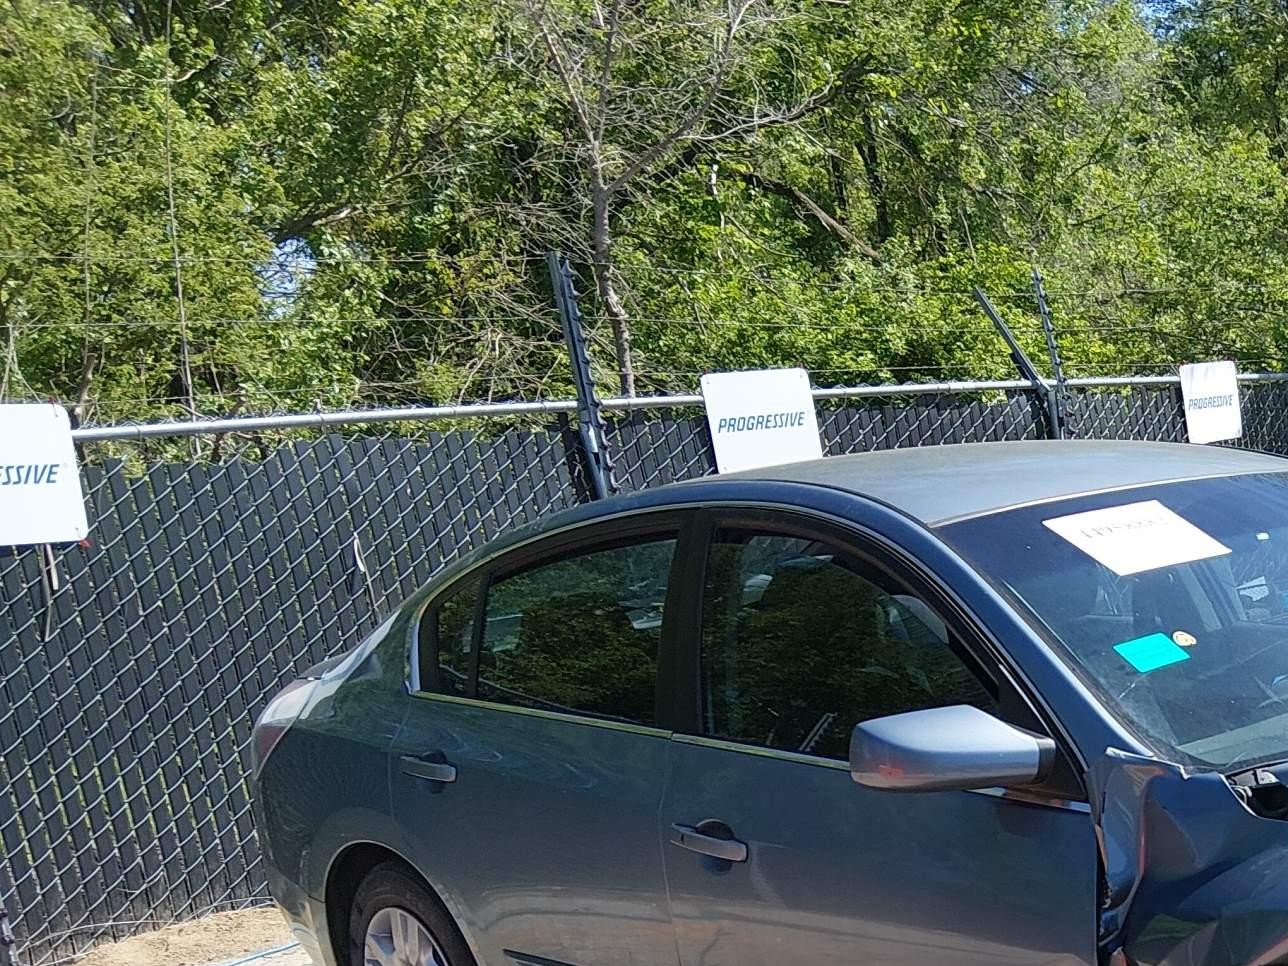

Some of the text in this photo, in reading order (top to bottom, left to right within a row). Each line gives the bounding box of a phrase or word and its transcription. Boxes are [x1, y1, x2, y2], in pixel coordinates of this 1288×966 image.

[1188, 394, 1233, 411] PROGRESSIVE
[717, 411, 806, 434] PROGRESSIVE
[0, 464, 60, 486] SSIVE
